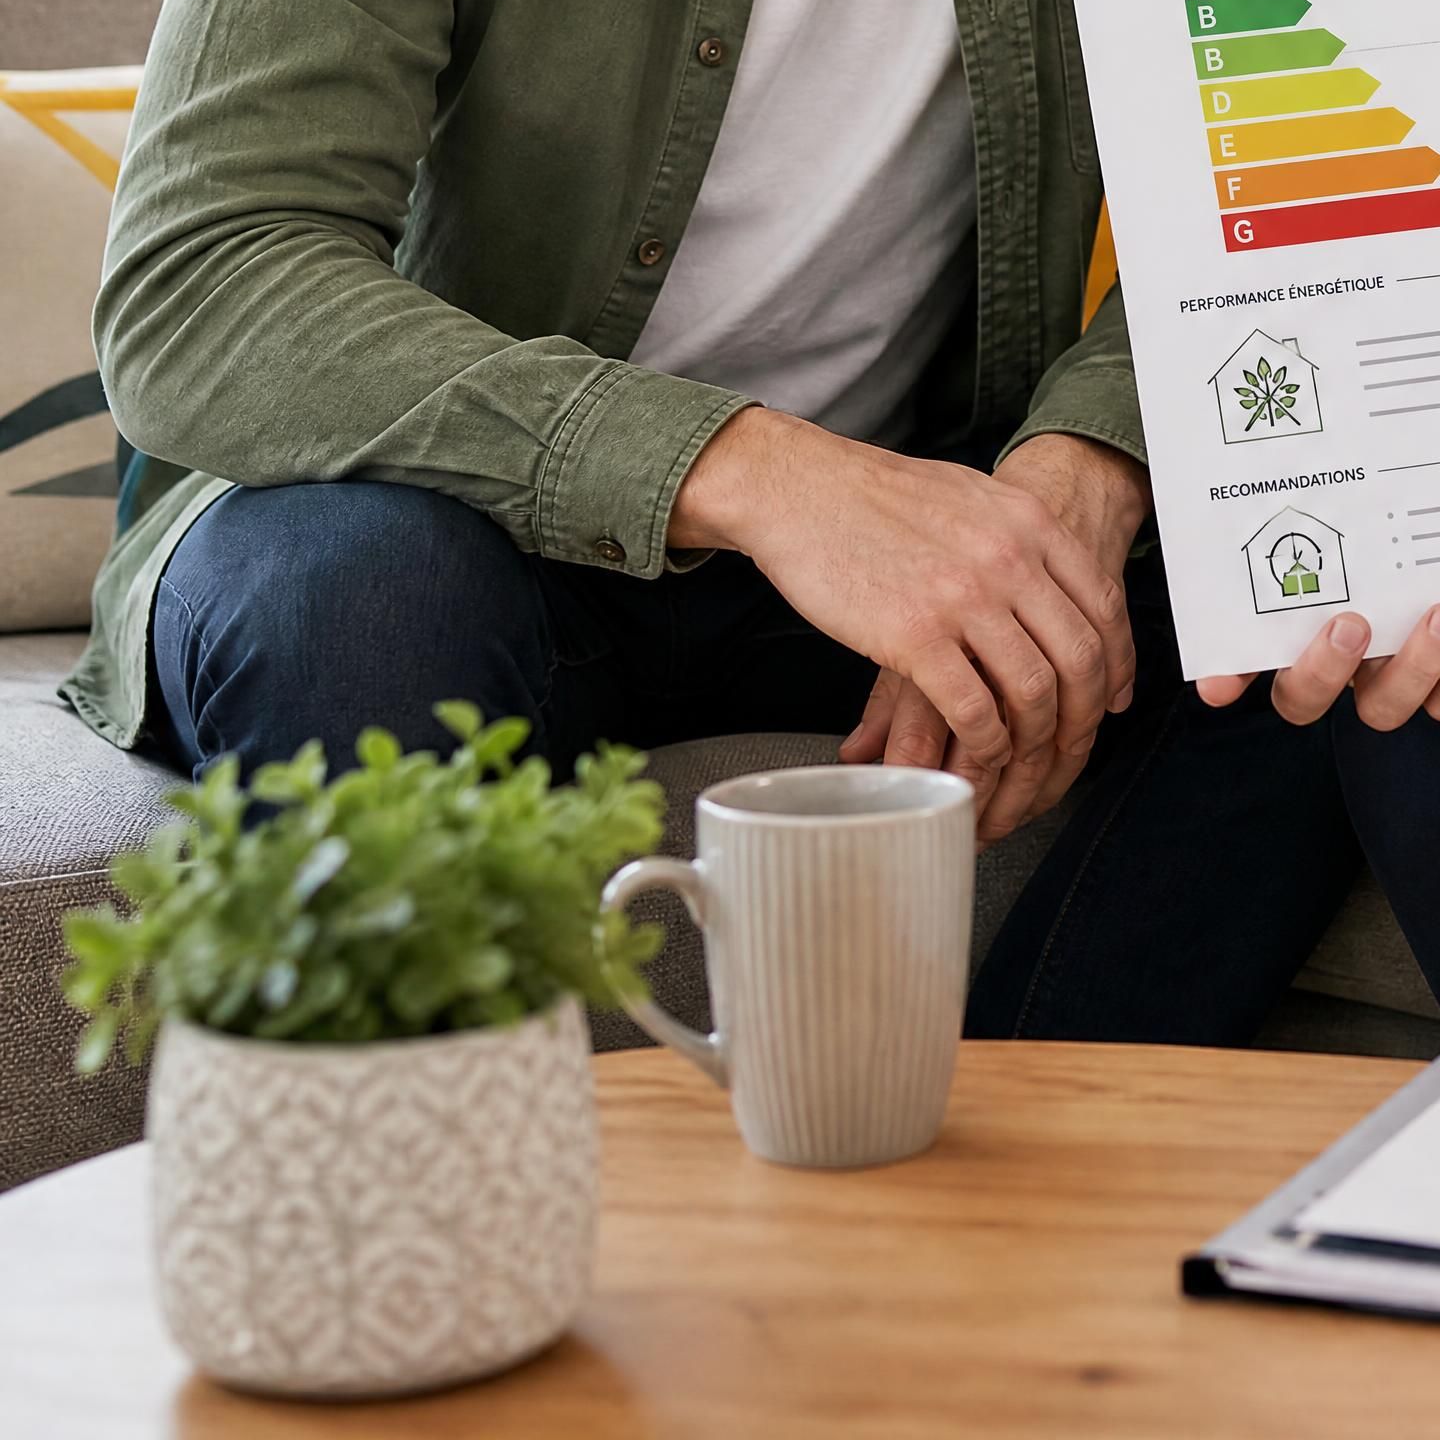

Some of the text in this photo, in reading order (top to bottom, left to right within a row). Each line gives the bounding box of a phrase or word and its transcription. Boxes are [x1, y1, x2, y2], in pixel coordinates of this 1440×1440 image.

[1197, 5, 1217, 29] B
[1204, 47, 1224, 72] B
[1212, 91, 1232, 114] D
[1219, 133, 1237, 158] E
[1226, 176, 1242, 201] F
[1233, 219, 1255, 244] G
[1179, 275, 1385, 313] PERFORMANCE ÉNERGÉTIQUE
[1209, 466, 1366, 501] RECOMMANDATIONS
